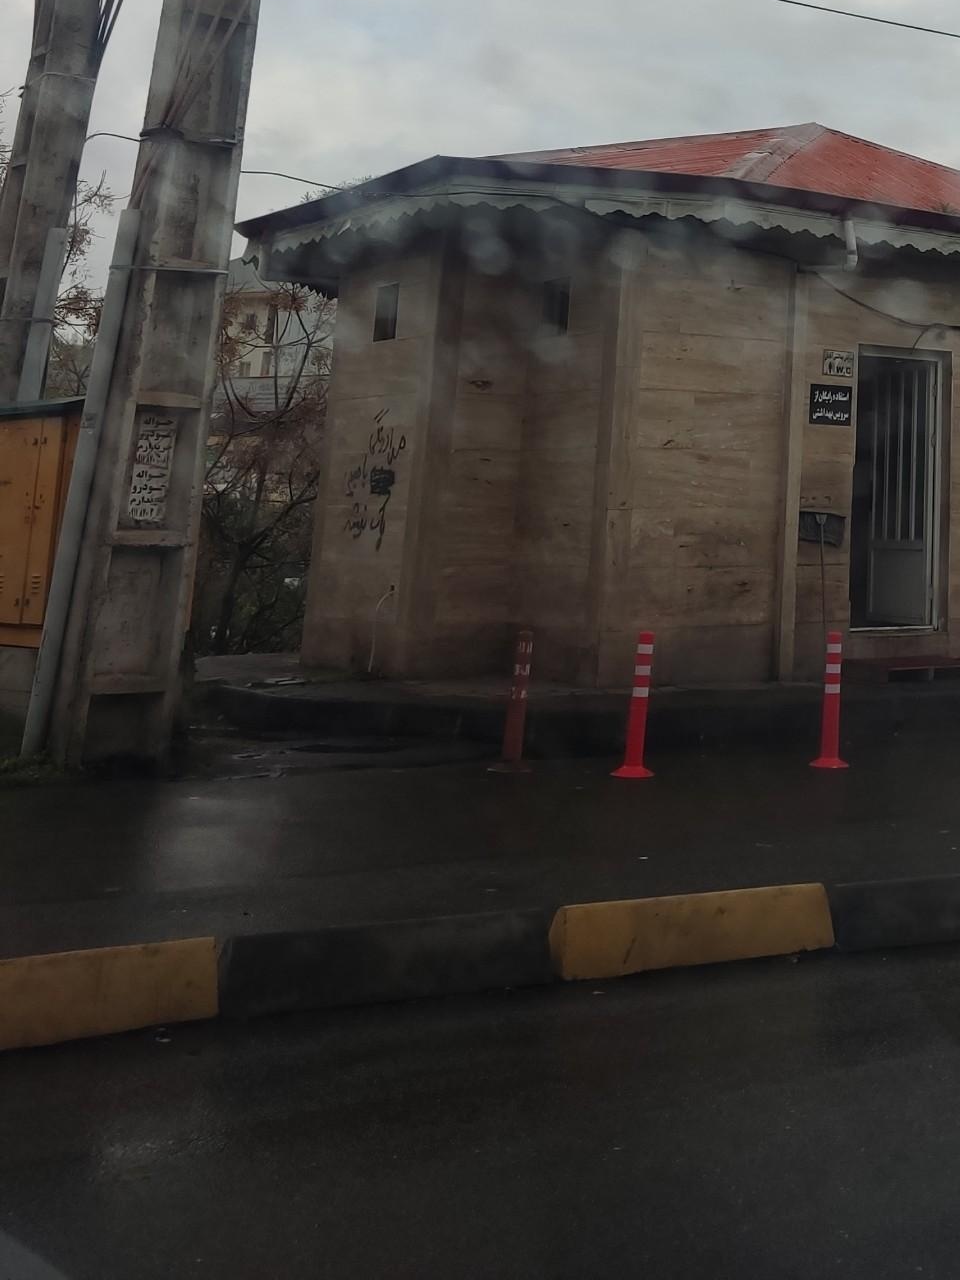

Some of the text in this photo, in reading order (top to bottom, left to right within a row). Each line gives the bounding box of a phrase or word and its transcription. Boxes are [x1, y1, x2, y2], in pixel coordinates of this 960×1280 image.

[818, 390, 833, 403] رایگان
[833, 391, 850, 401] استفاده
[812, 408, 849, 421] سرویس بهداشتی
[143, 417, 174, 428] حواله
[135, 470, 167, 481] حواله
[131, 483, 166, 494] خودرو
